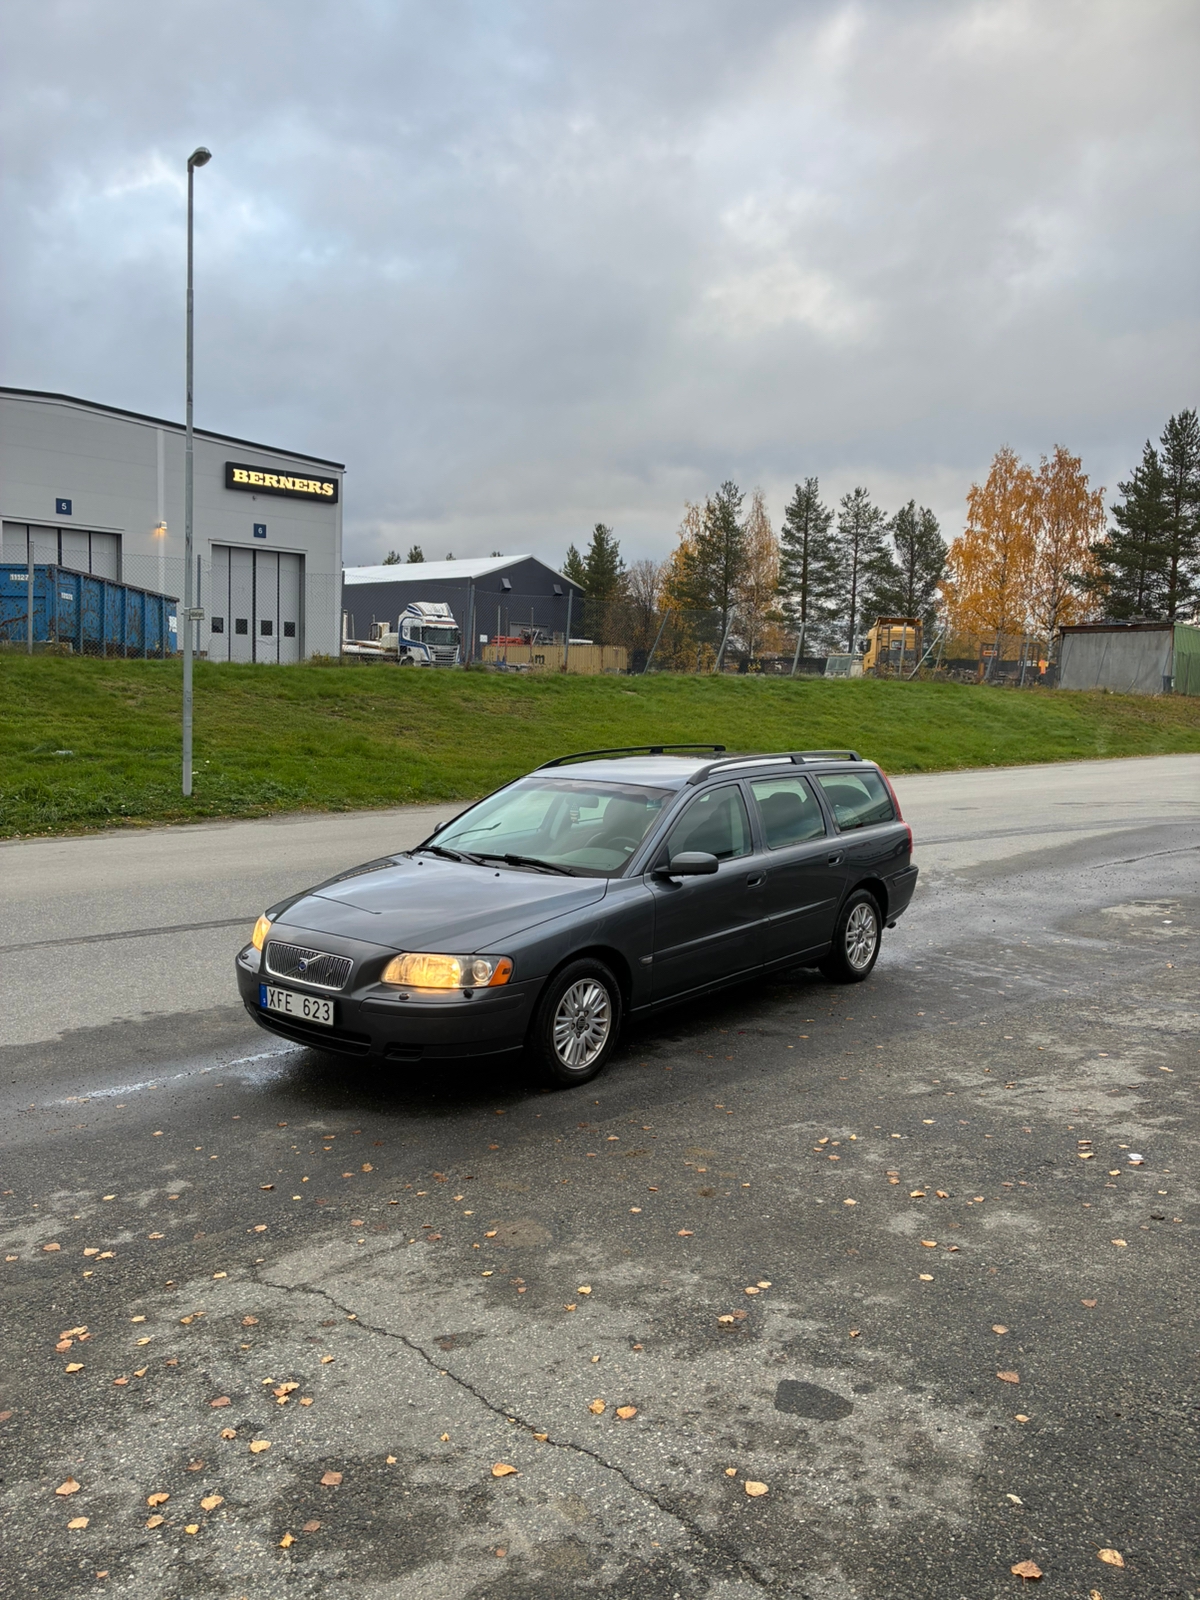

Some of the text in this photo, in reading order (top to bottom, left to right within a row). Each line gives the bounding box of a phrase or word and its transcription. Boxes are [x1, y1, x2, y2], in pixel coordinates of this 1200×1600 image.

[233, 468, 334, 496] BERNERS
[61, 502, 67, 511] 5
[257, 527, 263, 535] 6
[268, 988, 330, 1022] XFE 623
